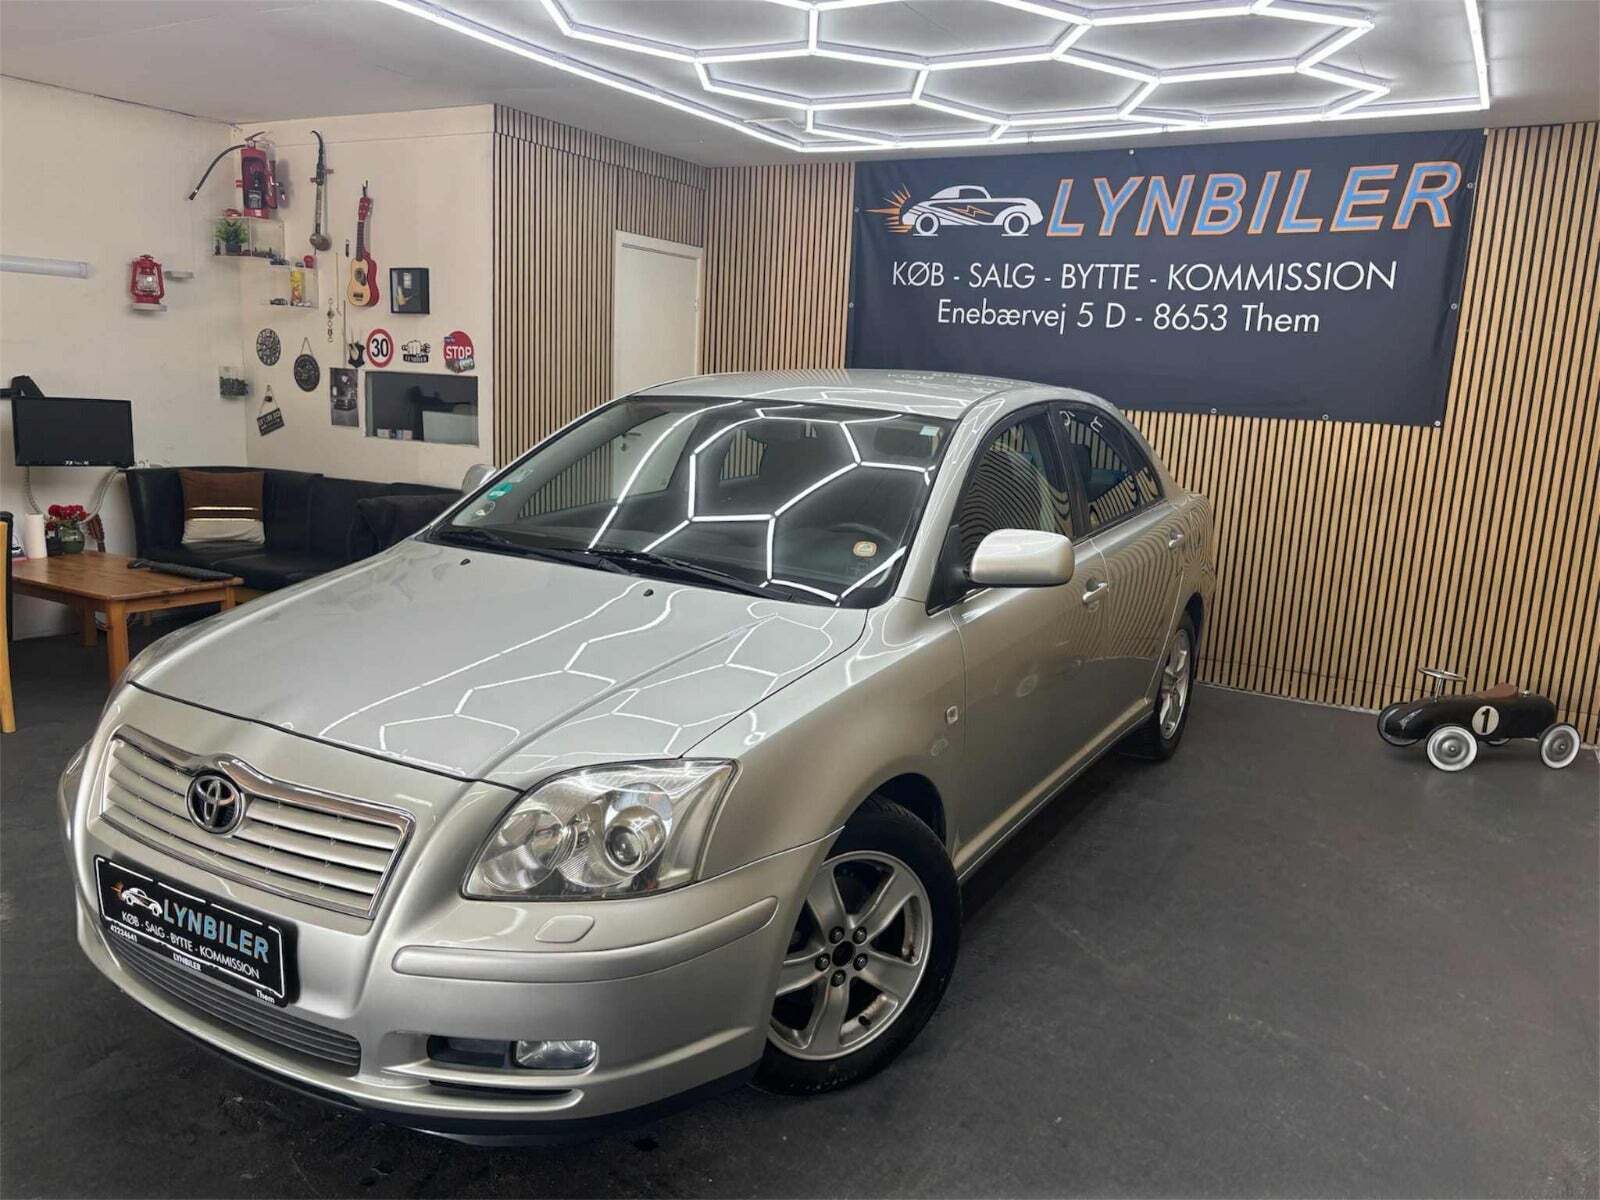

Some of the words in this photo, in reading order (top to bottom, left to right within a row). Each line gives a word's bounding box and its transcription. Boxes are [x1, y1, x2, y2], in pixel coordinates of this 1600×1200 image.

[1045, 161, 1461, 238] LYNBILER
[892, 260, 945, 287] KØB
[968, 262, 1036, 289] SALG
[1061, 263, 1140, 290] BYTTE
[1167, 260, 1397, 291] KOMMISSION
[937, 298, 1068, 335] Enebærvej
[1077, 302, 1094, 328] 5
[1105, 302, 1126, 329] D
[1153, 303, 1228, 331] 8653
[1241, 302, 1320, 332] Them
[371, 338, 389, 357] 30
[445, 345, 472, 359] STOP
[1481, 707, 1490, 733] 1
[121, 911, 140, 927] KØB
[145, 921, 165, 939] SALG
[170, 933, 194, 952] BYTTE
[200, 945, 260, 979] KOMMISSION
[163, 900, 269, 963] LYNBILER
[173, 953, 201, 971] LYNBILER
